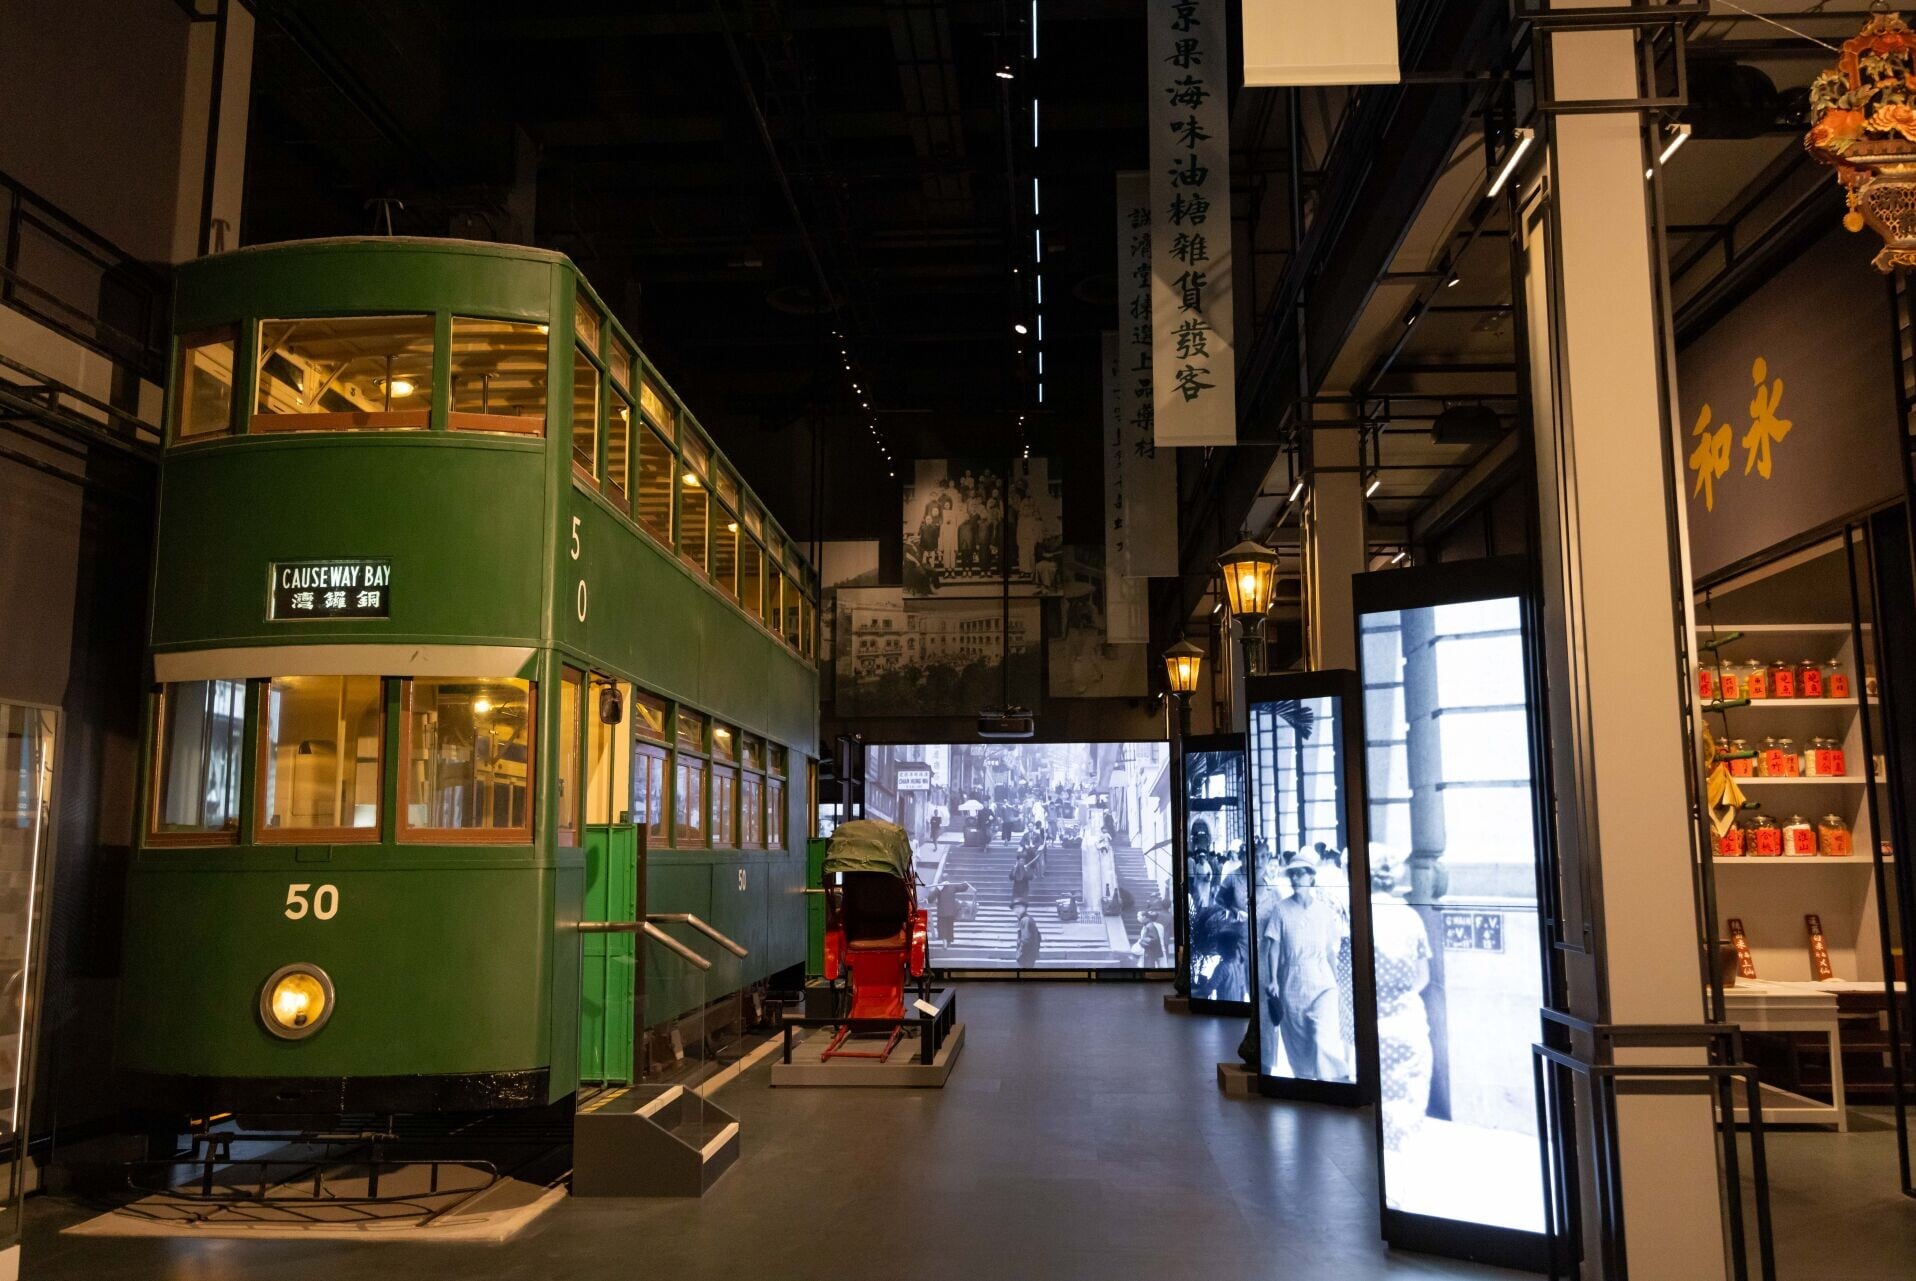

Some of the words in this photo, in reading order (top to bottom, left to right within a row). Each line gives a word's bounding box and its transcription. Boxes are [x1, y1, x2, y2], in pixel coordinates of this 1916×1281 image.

[1164, 0, 1217, 402] 京果海味油糖雜貨發客
[282, 566, 360, 589] CAUSEWAY
[364, 564, 391, 587] BAY
[738, 868, 747, 891] 50
[284, 883, 339, 920] 50
